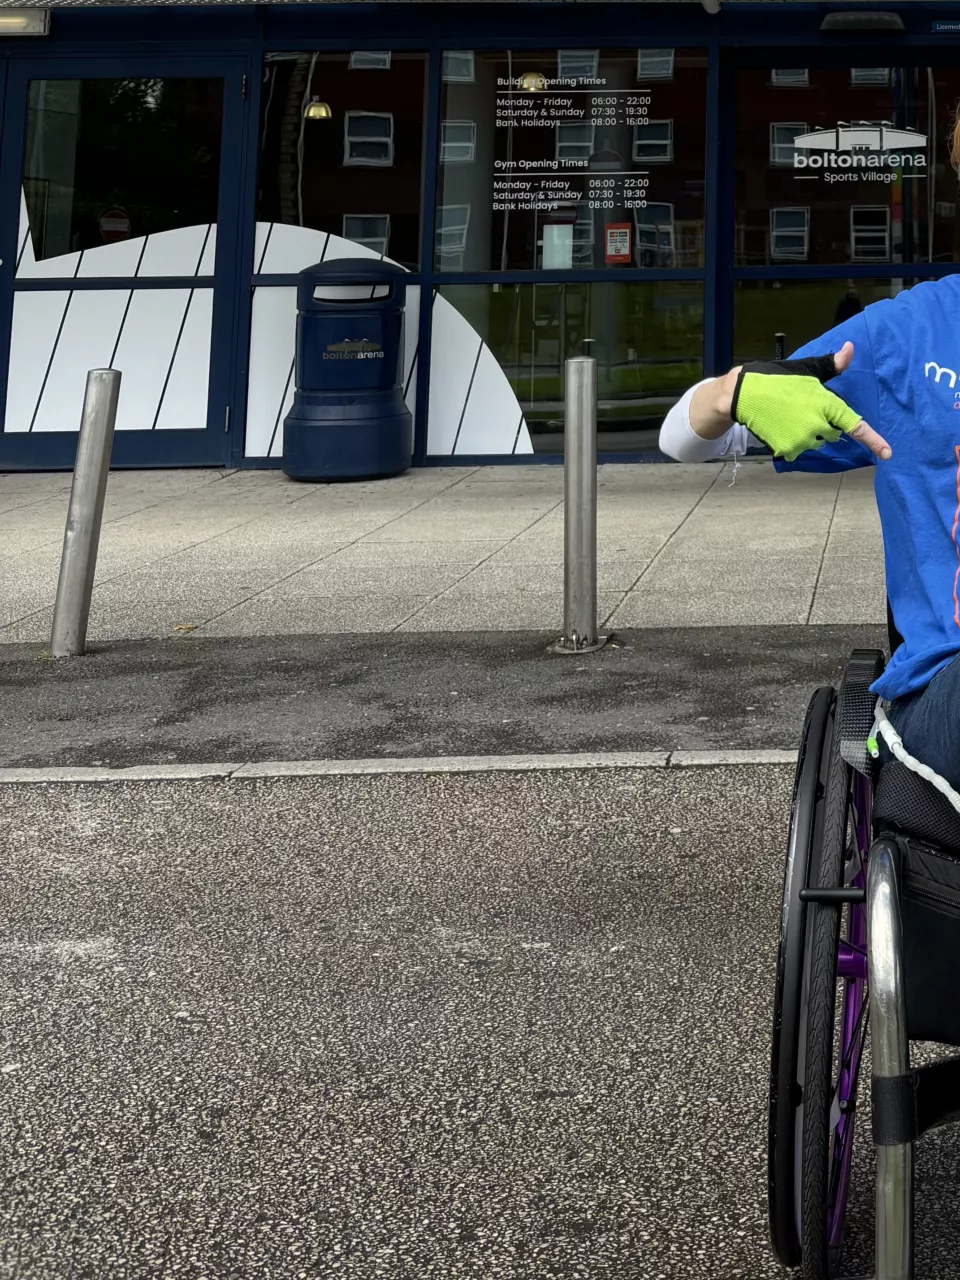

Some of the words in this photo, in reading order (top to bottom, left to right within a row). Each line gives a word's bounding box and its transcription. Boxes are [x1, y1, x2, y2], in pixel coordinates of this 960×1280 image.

[497, 77, 535, 87] Building
[537, 77, 577, 87] Opening
[578, 76, 607, 85] Times
[496, 98, 535, 108] Monday
[543, 97, 573, 107] Friday
[591, 97, 617, 105] 06:00
[626, 97, 651, 105] 22:00
[496, 108, 539, 118] Saturday
[549, 108, 585, 118] Sunday
[591, 108, 616, 116] 07:30
[625, 107, 648, 115] 19:30
[495, 119, 519, 127] Bank
[521, 119, 561, 129] Holidays
[591, 118, 617, 126] 08:00
[626, 118, 649, 126] 16:00
[494, 160, 517, 169] Gym
[518, 160, 559, 169] Opening
[560, 159, 589, 167] Times
[793, 152, 927, 168] boltonarena
[824, 172, 859, 184] Sports
[861, 171, 898, 184] Village
[493, 181, 532, 191] Monday
[540, 180, 570, 190] Friday
[624, 179, 649, 187] 22:00
[493, 192, 536, 201] Saturday
[547, 191, 583, 201] Sunday
[588, 190, 614, 198] 07:30
[492, 202, 516, 210] Bank
[517, 202, 558, 212] Holidays
[588, 201, 614, 209] 08:00
[624, 200, 647, 208] 16:00
